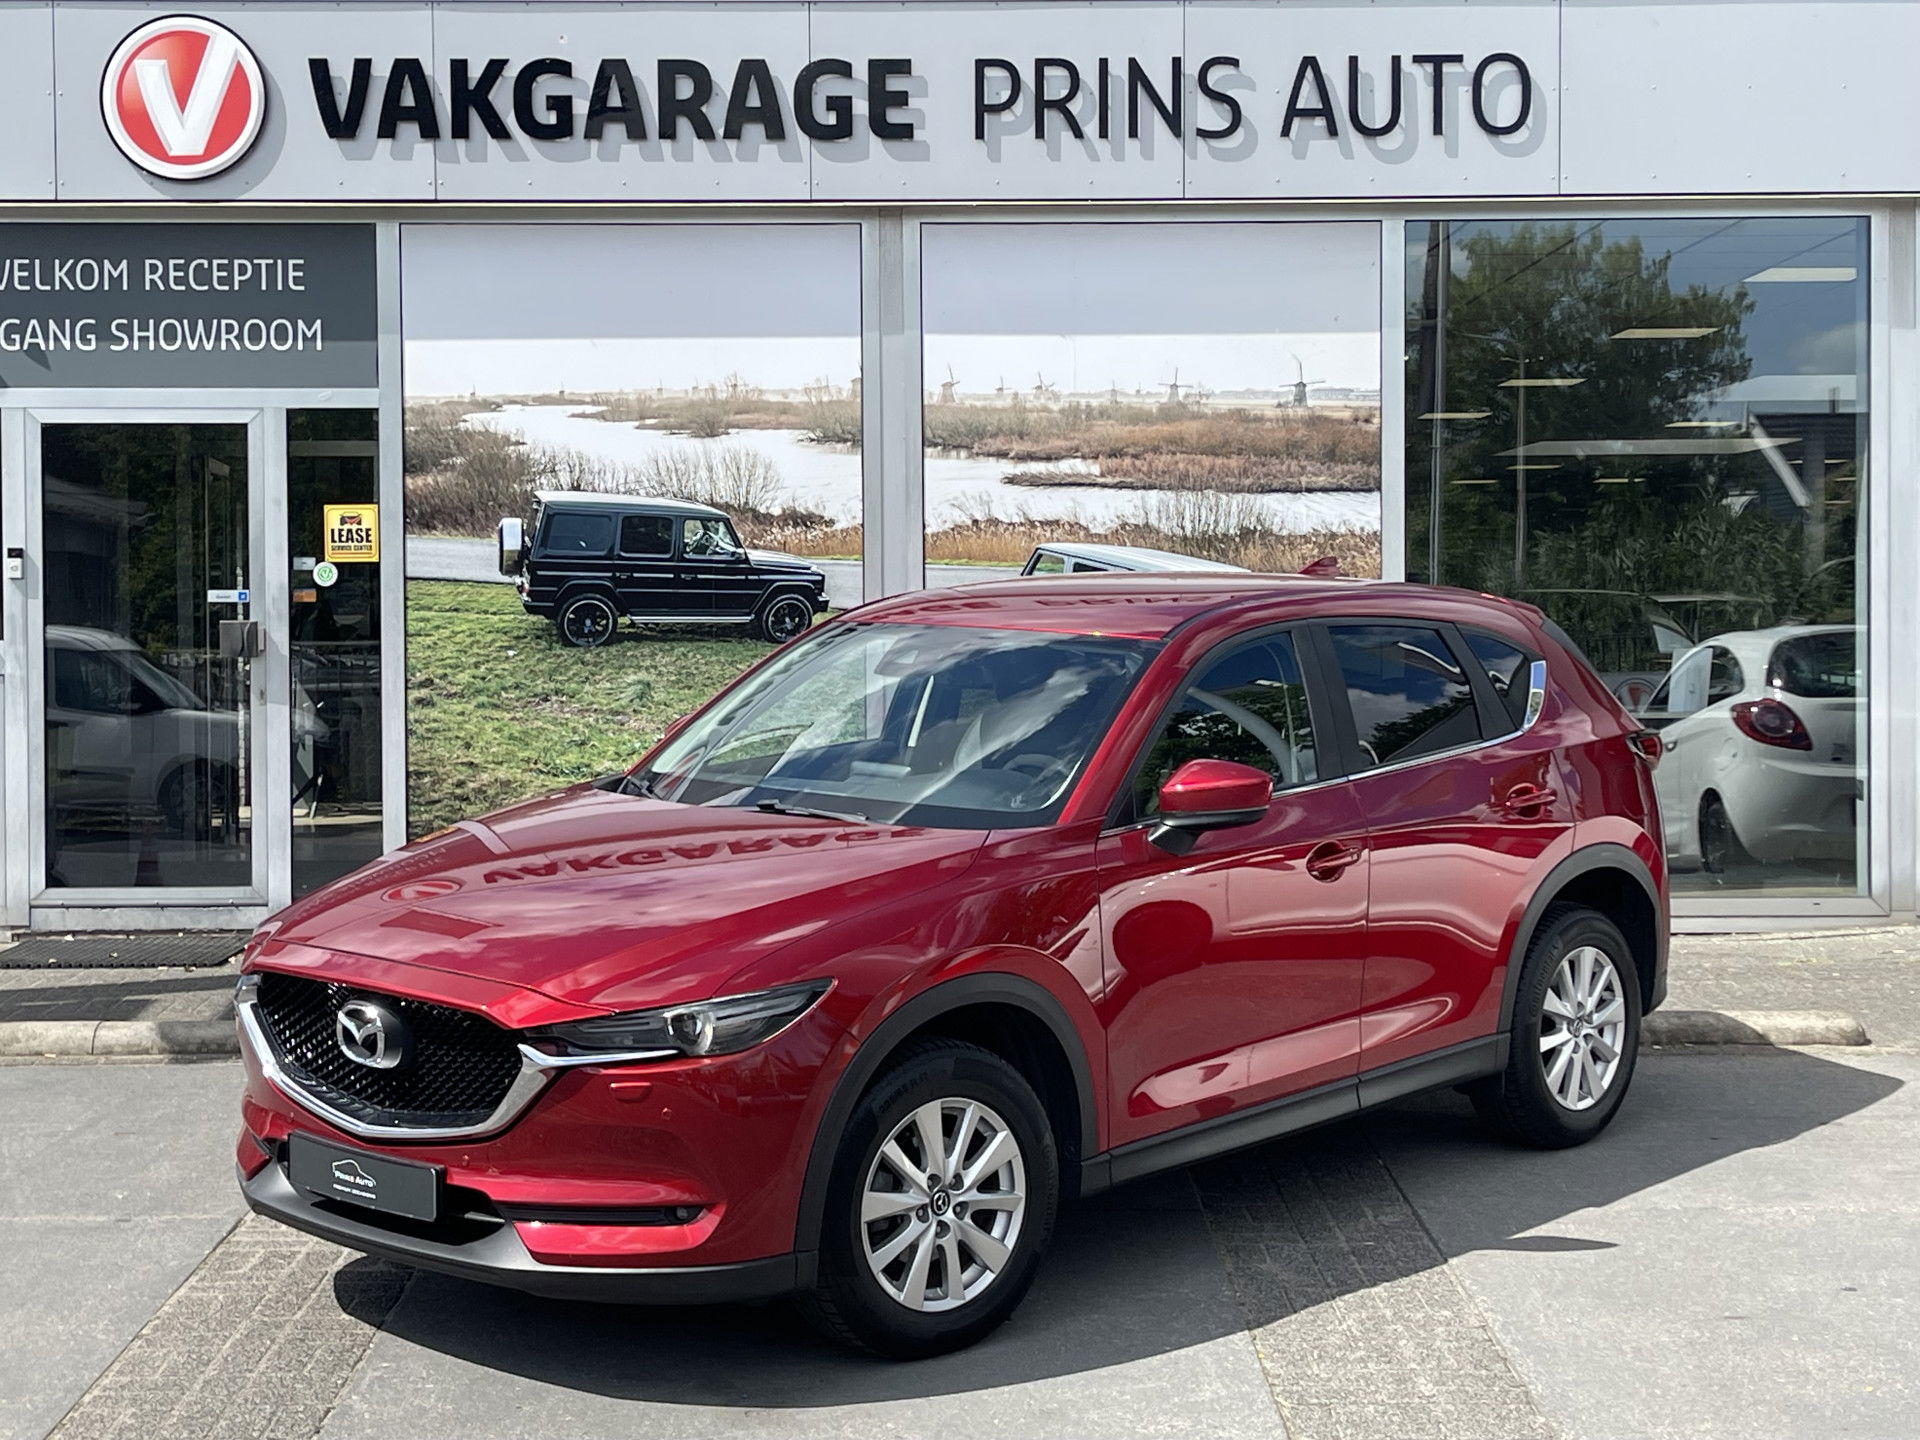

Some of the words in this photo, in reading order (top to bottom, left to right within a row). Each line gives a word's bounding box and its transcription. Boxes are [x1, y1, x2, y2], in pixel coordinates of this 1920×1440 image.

[308, 57, 915, 141] VAKGARAGE
[974, 56, 1243, 141] PRINS
[1280, 52, 1533, 138] AUTO
[144, 258, 305, 291] RECEPTIE
[109, 318, 322, 351] SHOWROOM
[330, 528, 372, 543] LEASE
